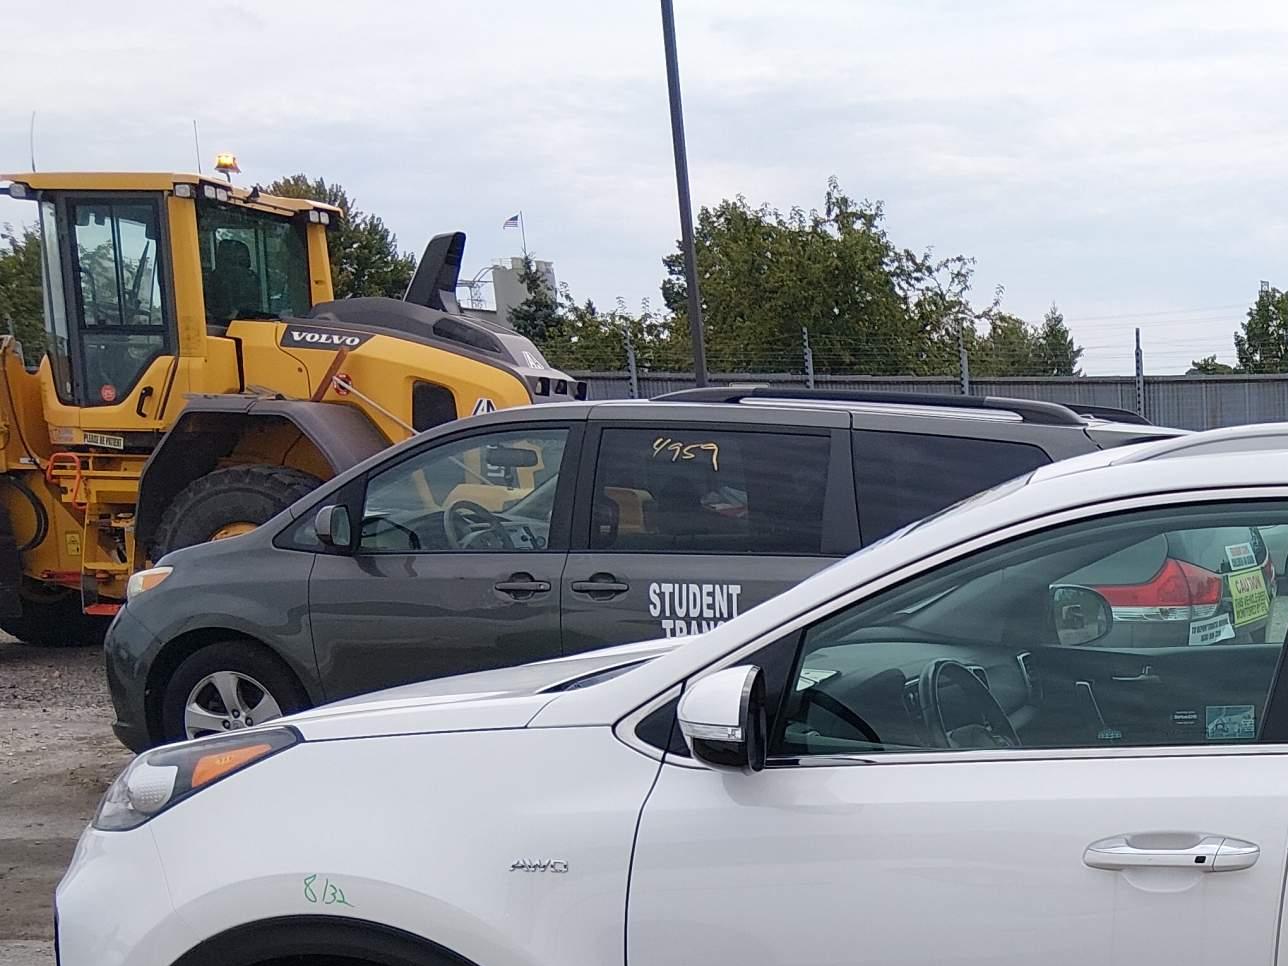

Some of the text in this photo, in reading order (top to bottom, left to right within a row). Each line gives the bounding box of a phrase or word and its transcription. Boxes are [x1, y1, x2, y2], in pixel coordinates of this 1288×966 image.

[291, 331, 360, 346] VOLVO
[1236, 575, 1262, 594] CAUTION
[649, 582, 741, 618] STUDENT
[509, 858, 569, 873] AWD
[303, 874, 355, 907] 8/32
